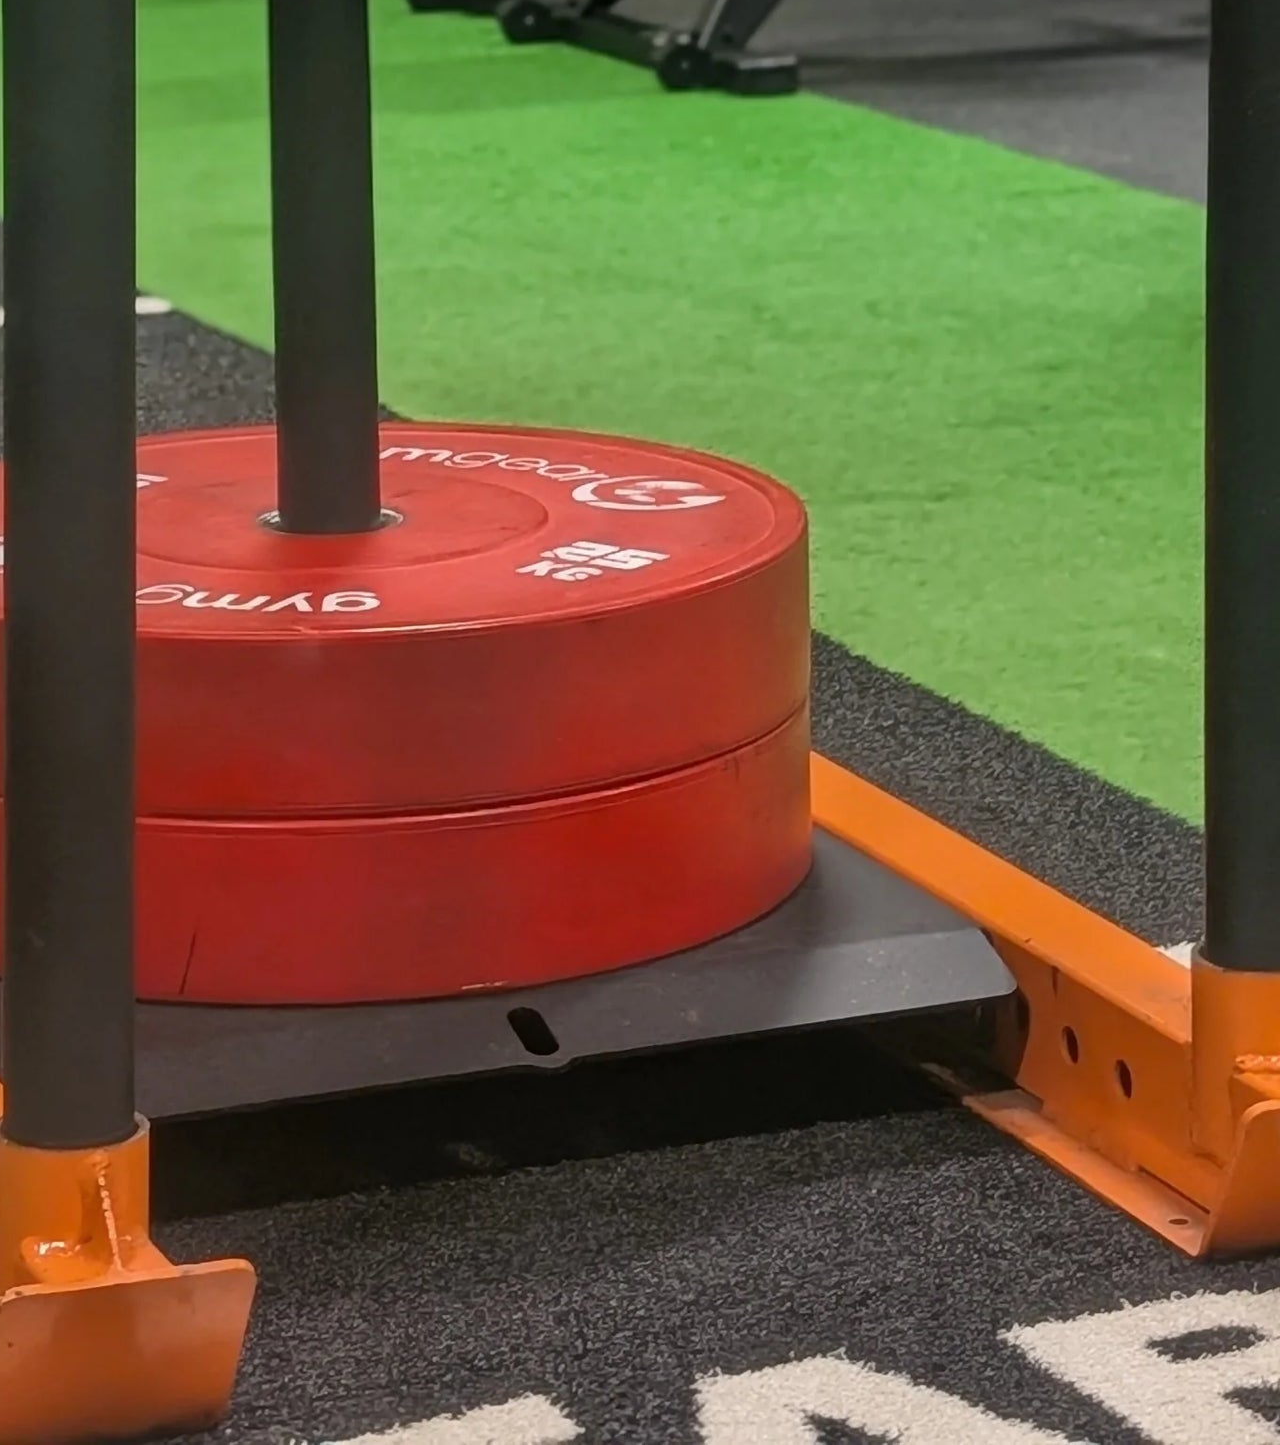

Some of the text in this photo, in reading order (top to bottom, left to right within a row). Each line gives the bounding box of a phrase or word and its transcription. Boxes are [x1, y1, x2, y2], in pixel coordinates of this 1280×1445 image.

[379, 446, 609, 482] mgear
[540, 540, 671, 570] 25
[136, 583, 381, 612] gymg
